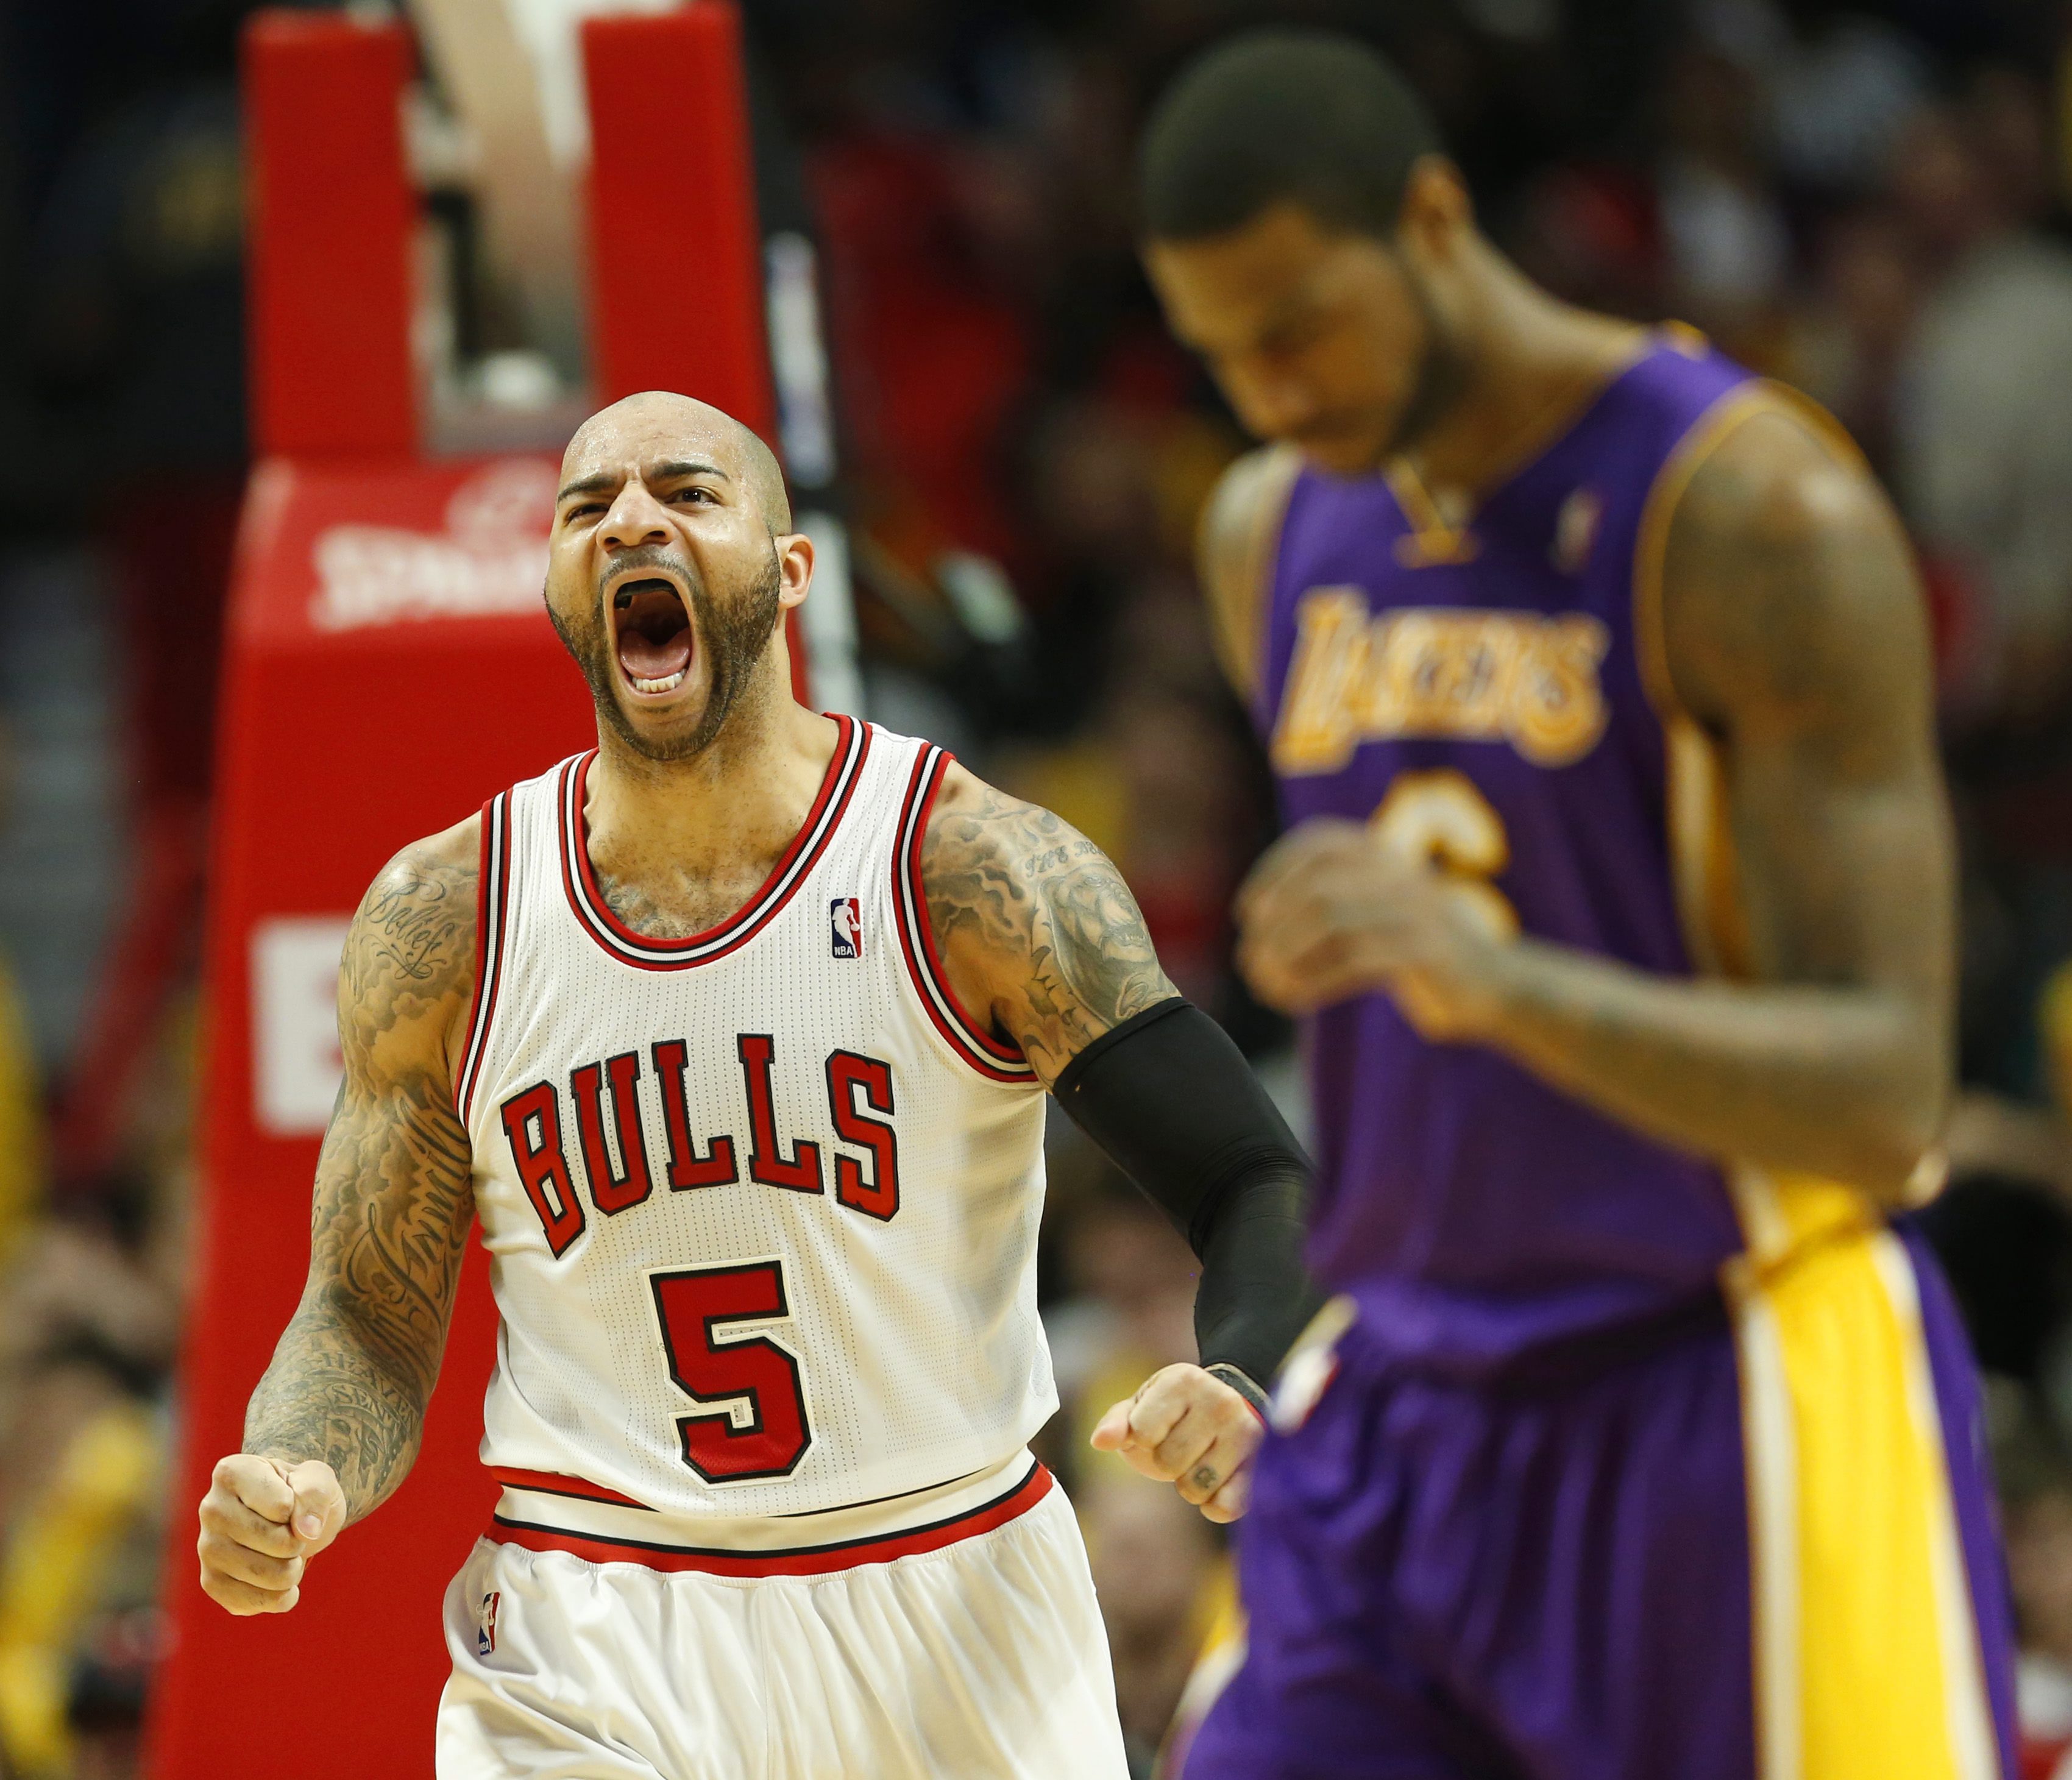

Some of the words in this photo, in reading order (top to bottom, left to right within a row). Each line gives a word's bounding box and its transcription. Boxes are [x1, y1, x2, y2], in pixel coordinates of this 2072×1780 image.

[834, 945, 853, 956] NBA
[500, 1033, 899, 1260] BULLS
[646, 1257, 815, 1486] 5
